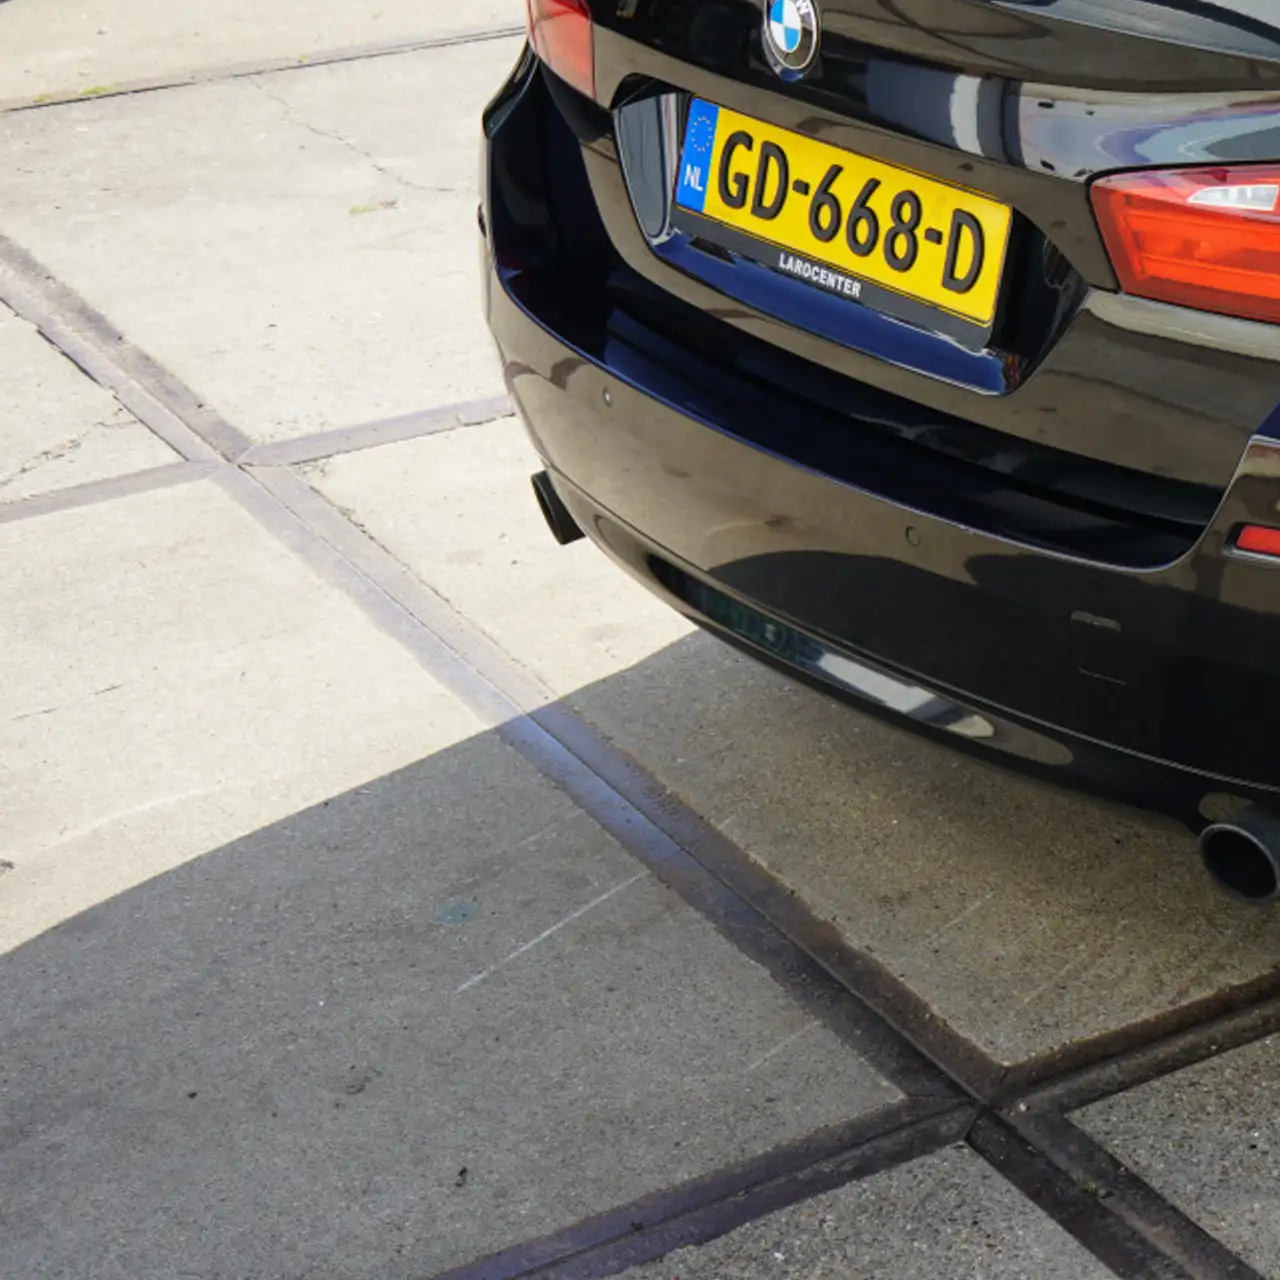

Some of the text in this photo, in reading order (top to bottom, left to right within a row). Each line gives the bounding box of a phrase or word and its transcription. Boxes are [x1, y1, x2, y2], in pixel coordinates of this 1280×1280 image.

[683, 163, 704, 192] NL
[717, 130, 986, 294] GD-668-D
[778, 252, 862, 298] LAROCENTER
